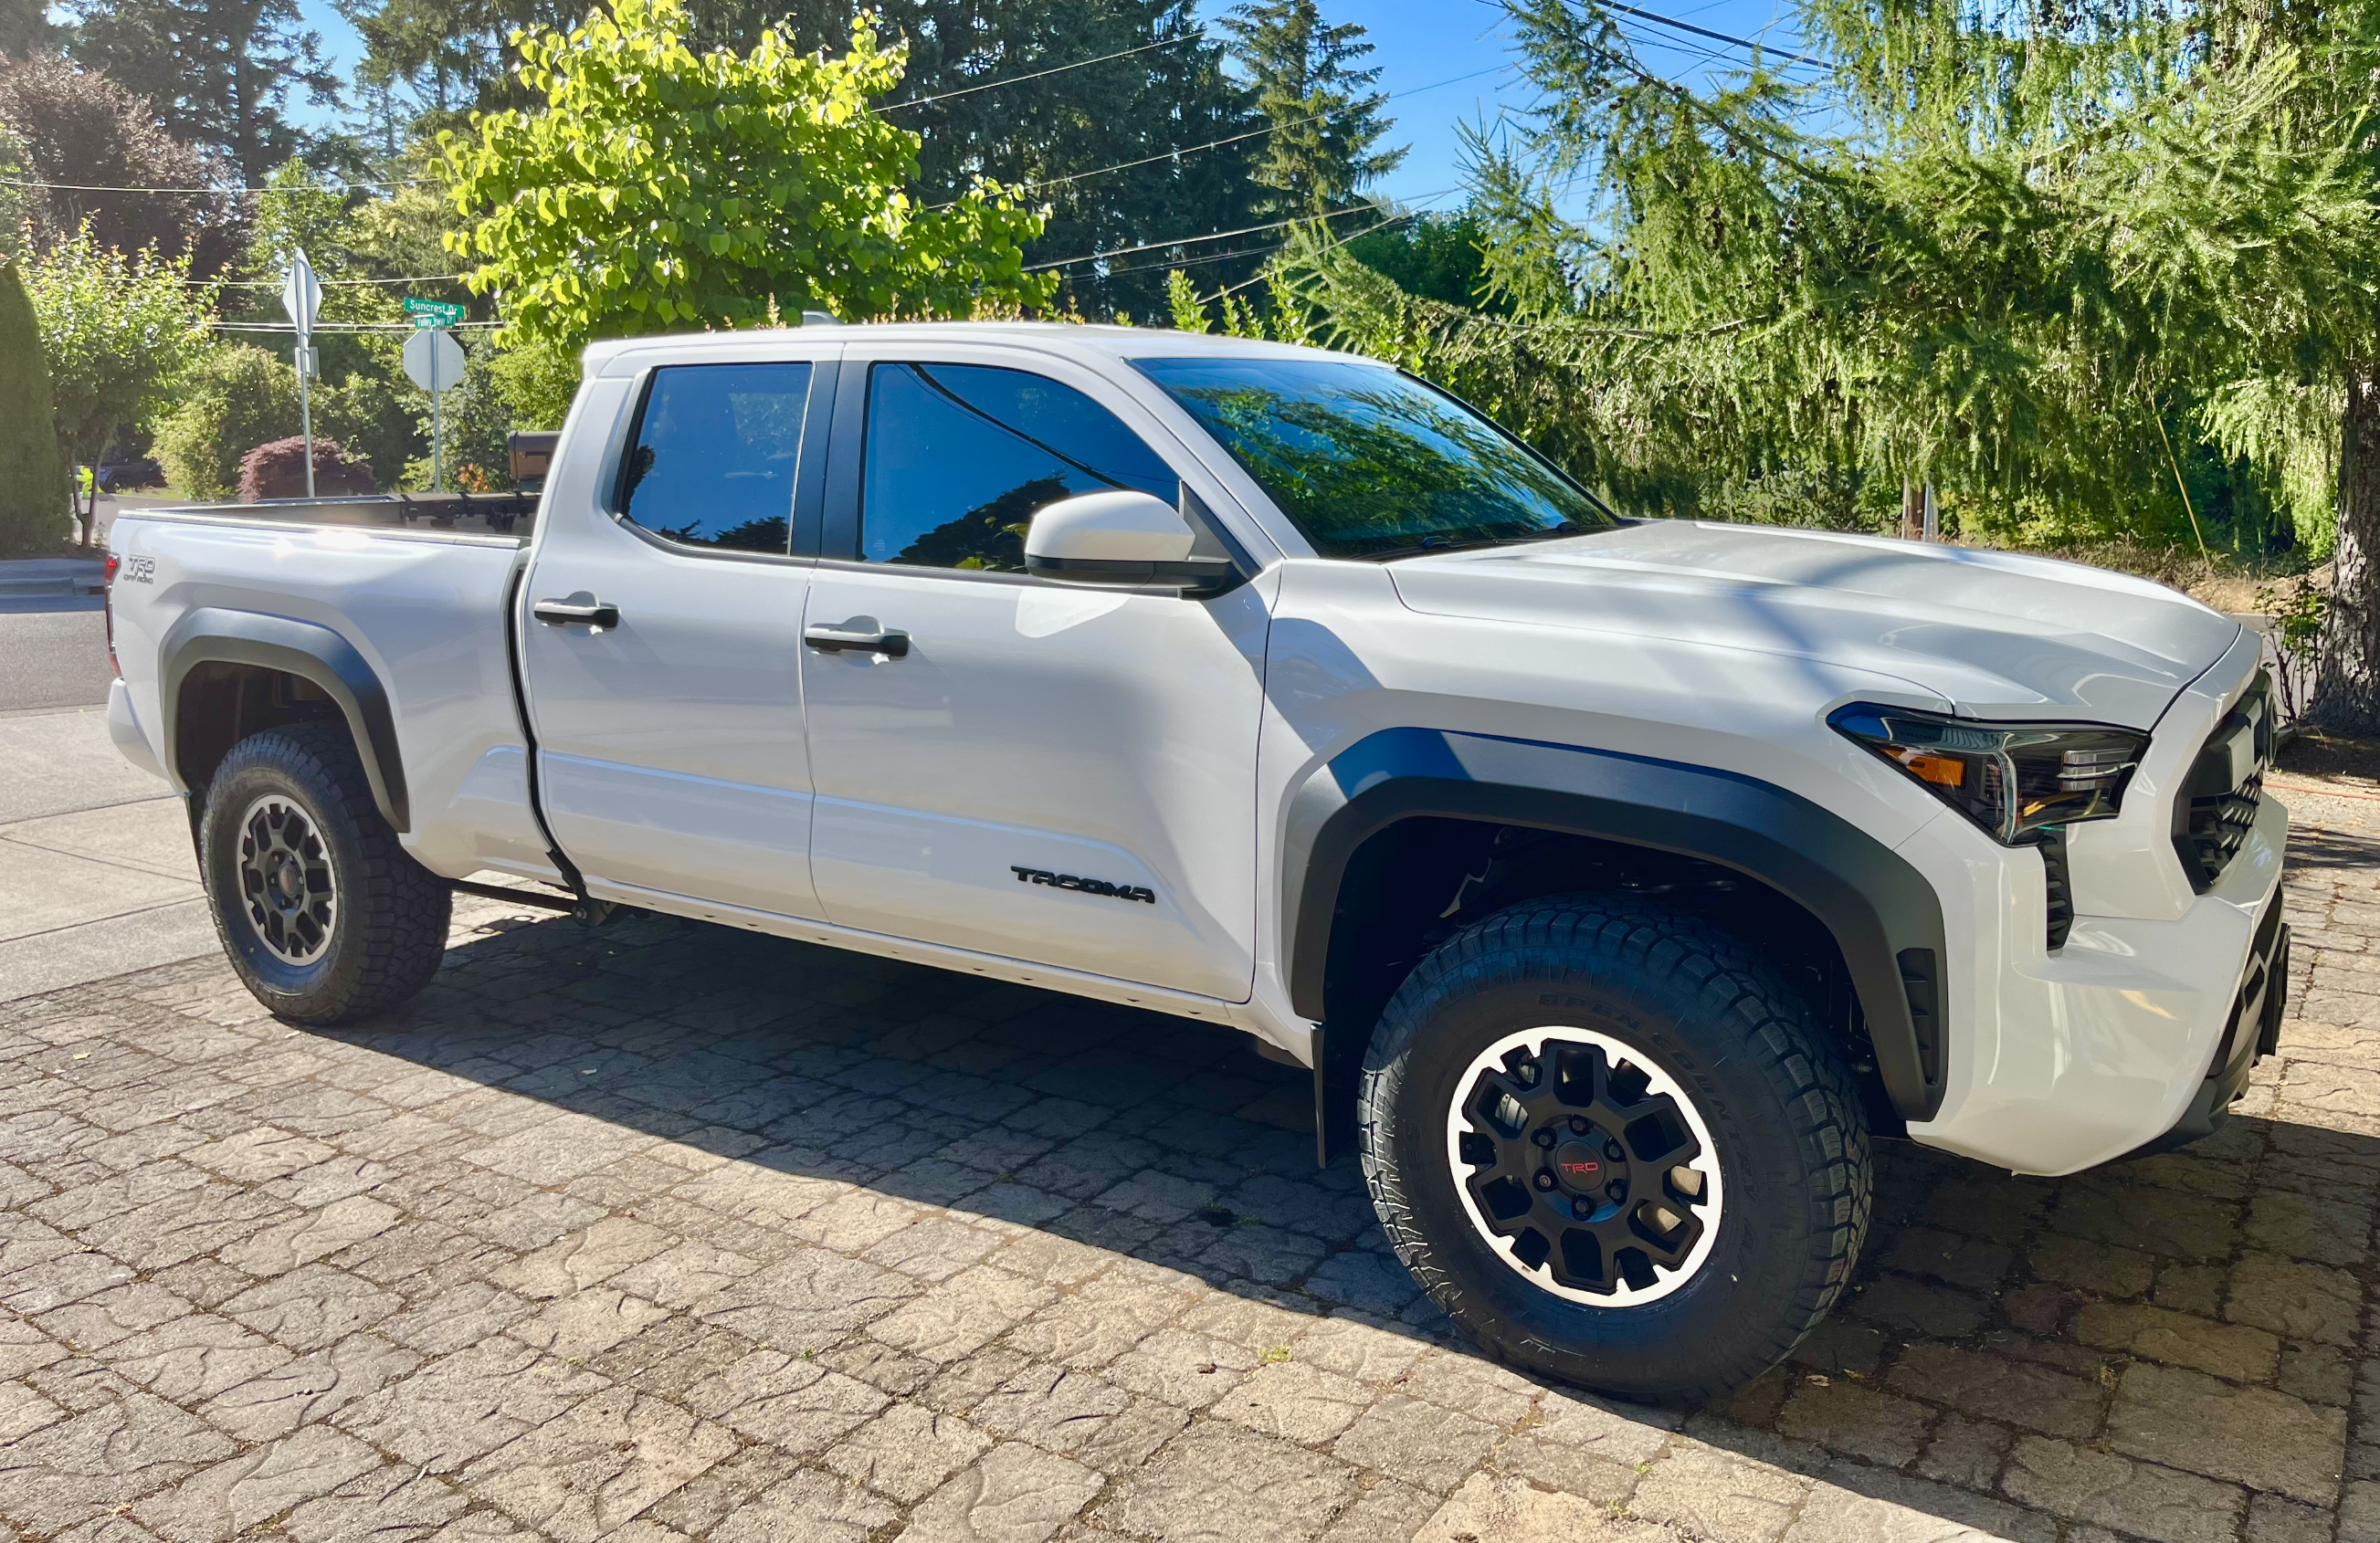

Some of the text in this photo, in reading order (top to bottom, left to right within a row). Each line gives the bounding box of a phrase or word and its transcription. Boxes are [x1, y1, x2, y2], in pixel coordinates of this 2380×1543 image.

[410, 299, 458, 314] Suncrest Dr
[417, 318, 432, 328] Valley
[448, 315, 453, 324] Dr
[129, 554, 155, 577] TRD
[1899, 731, 1942, 741] TACOM
[1010, 866, 1155, 904] TACOMA
[1539, 993, 1643, 1031] OPEN
[1649, 1032, 1757, 1204] COUNTRY
[1561, 1162, 1599, 1174] TRD
